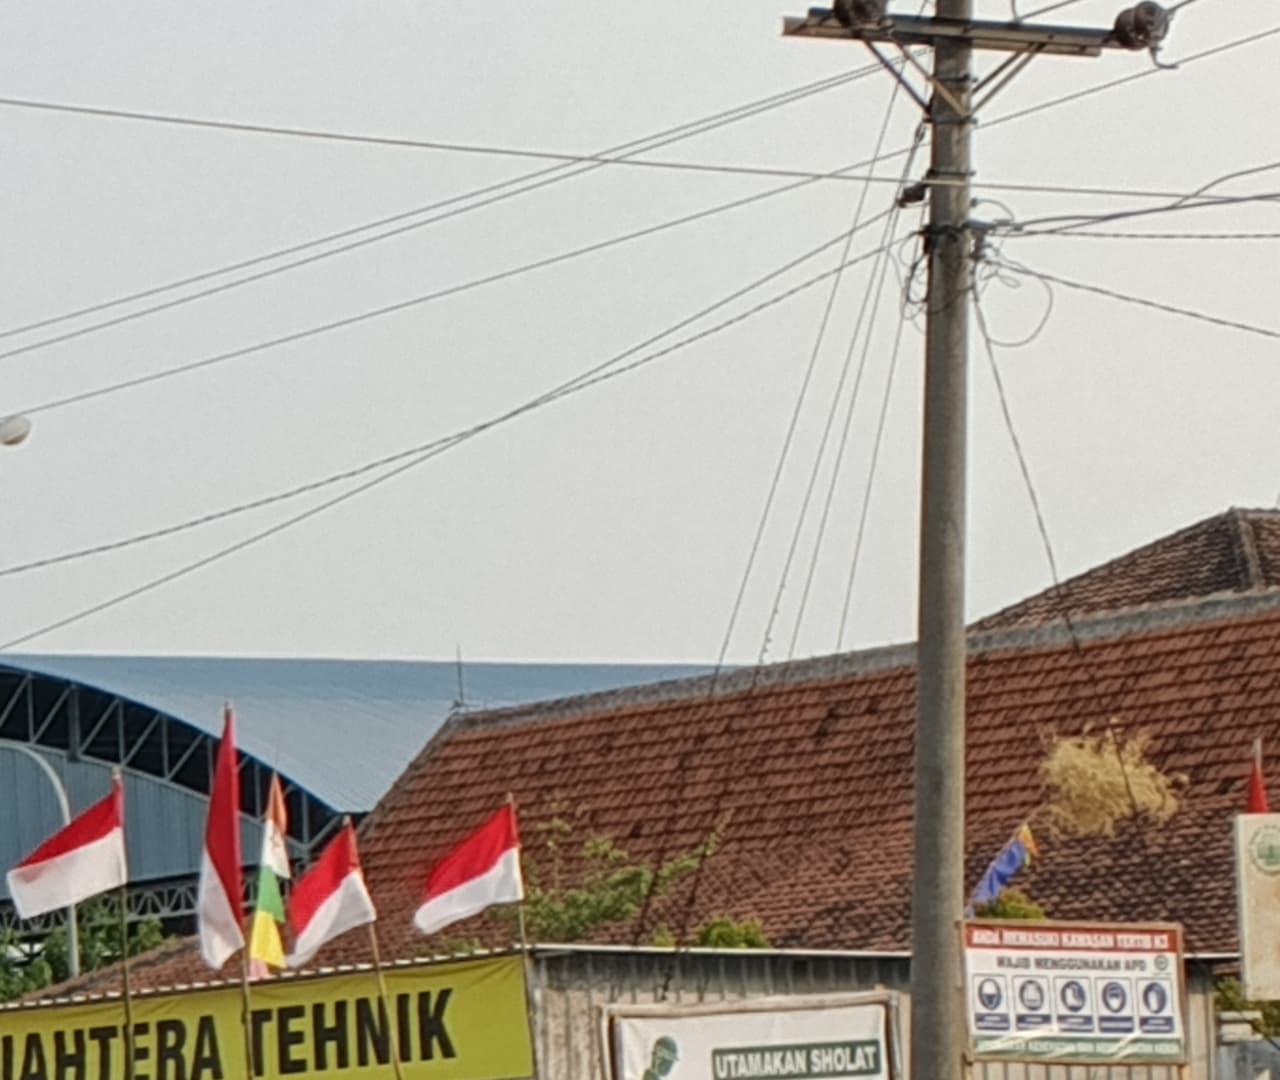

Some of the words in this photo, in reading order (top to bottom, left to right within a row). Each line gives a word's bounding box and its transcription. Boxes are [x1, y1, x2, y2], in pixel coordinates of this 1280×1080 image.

[242, 987, 457, 1078] TEHNIK
[715, 1050, 808, 1079] UTAMAKAN
[810, 1045, 878, 1072] SHOLAT
